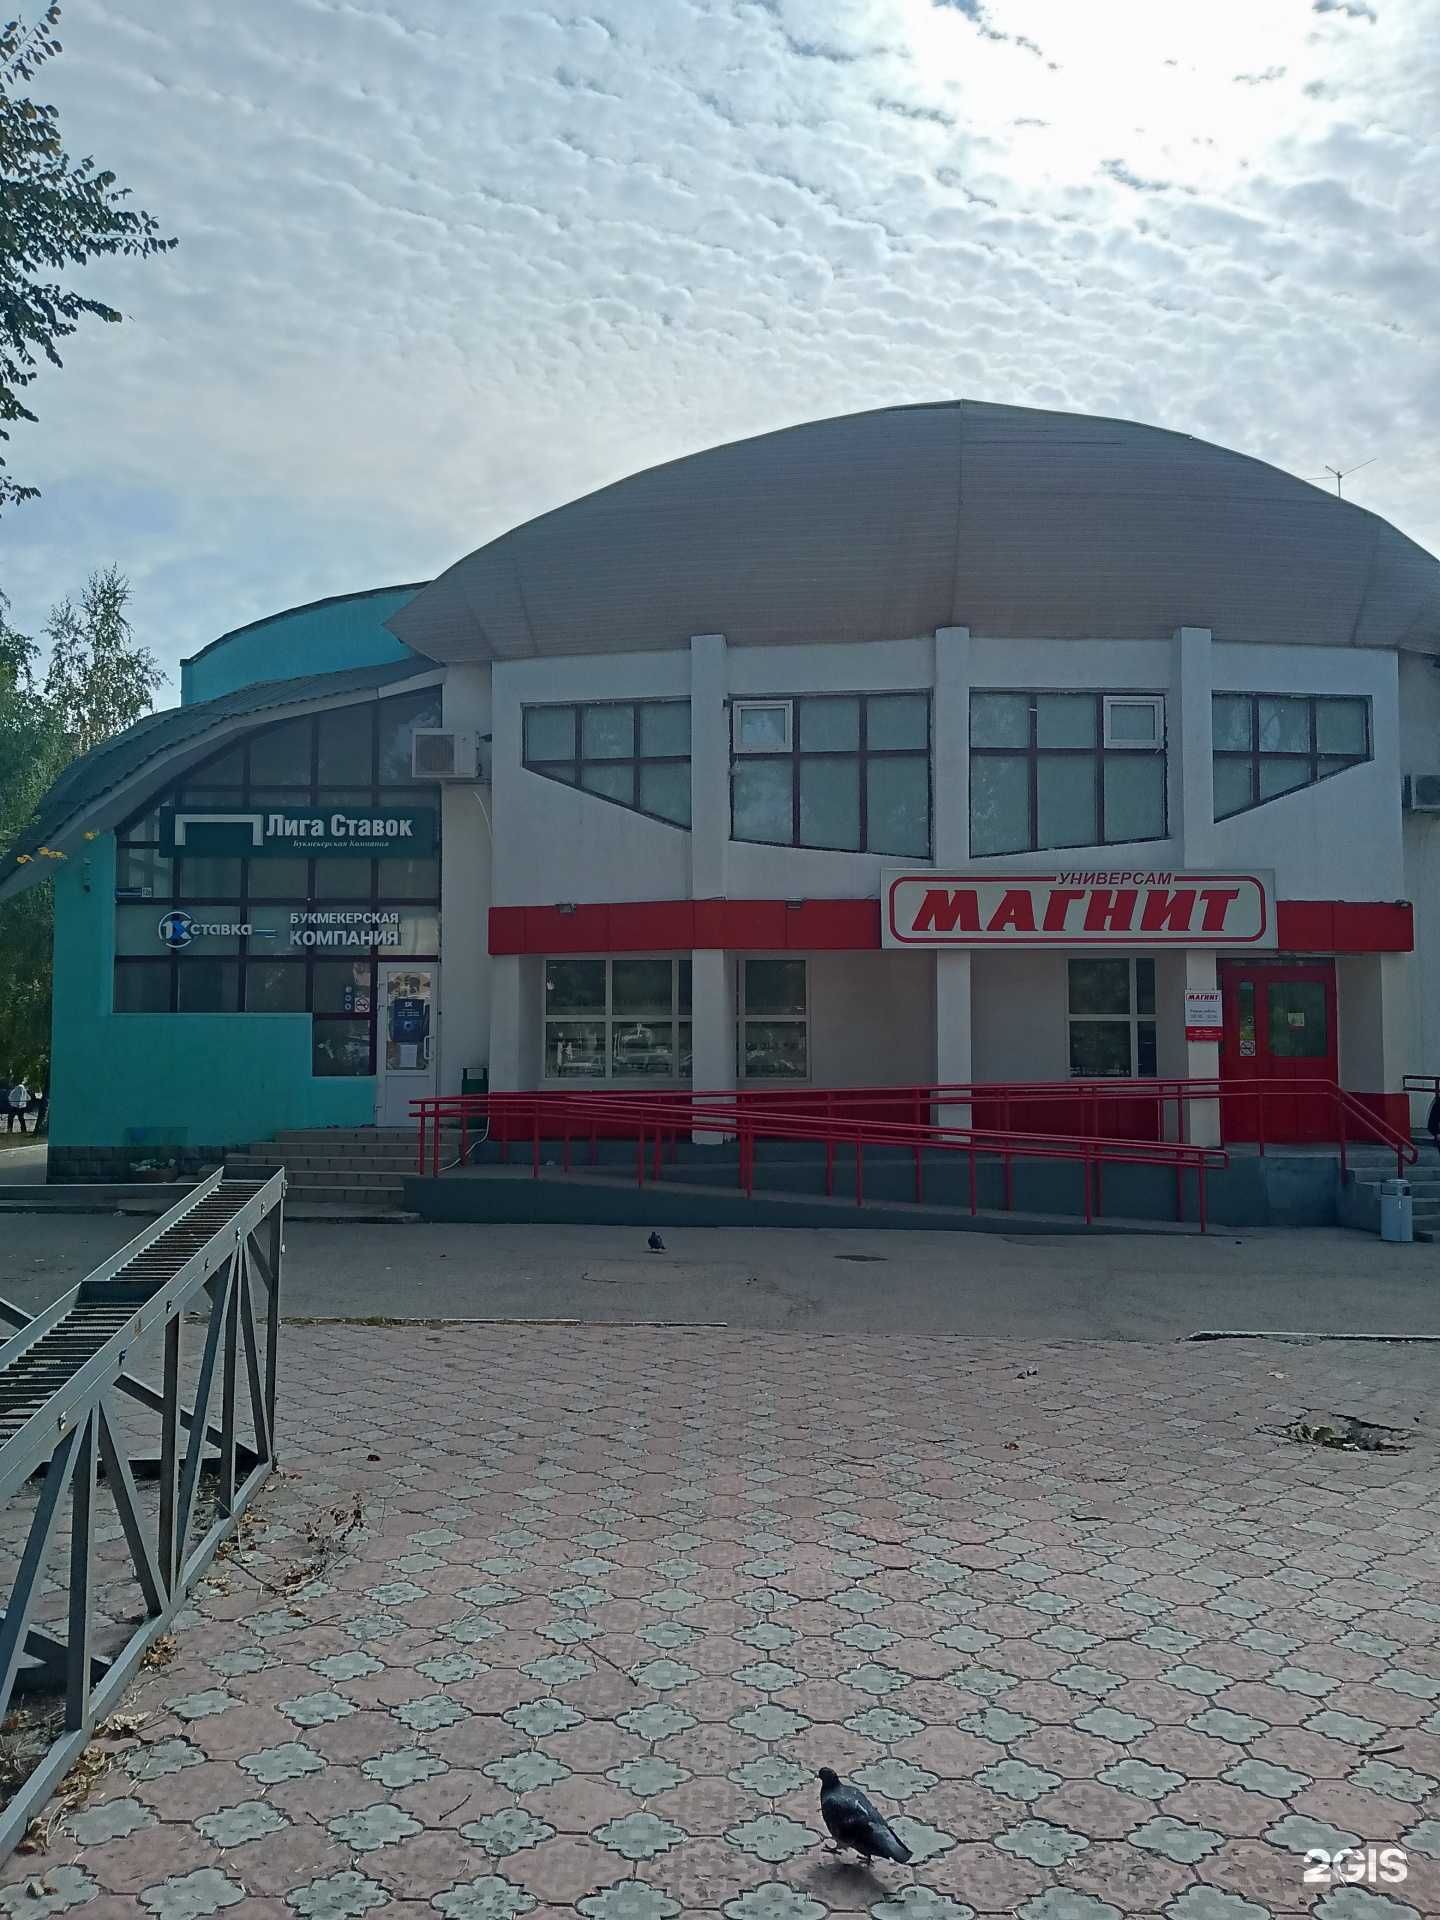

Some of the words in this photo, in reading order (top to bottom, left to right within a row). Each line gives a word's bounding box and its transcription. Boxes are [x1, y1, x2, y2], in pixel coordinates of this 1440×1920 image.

[266, 814, 324, 837] Лига
[331, 814, 413, 837] Ставок
[1058, 872, 1172, 886] УНИВЕРСАМ
[289, 912, 399, 924] БУКМЕКЕРСКАЯ
[911, 889, 1240, 932] МАГНИТ
[289, 930, 399, 946] КОМПАНИЯ
